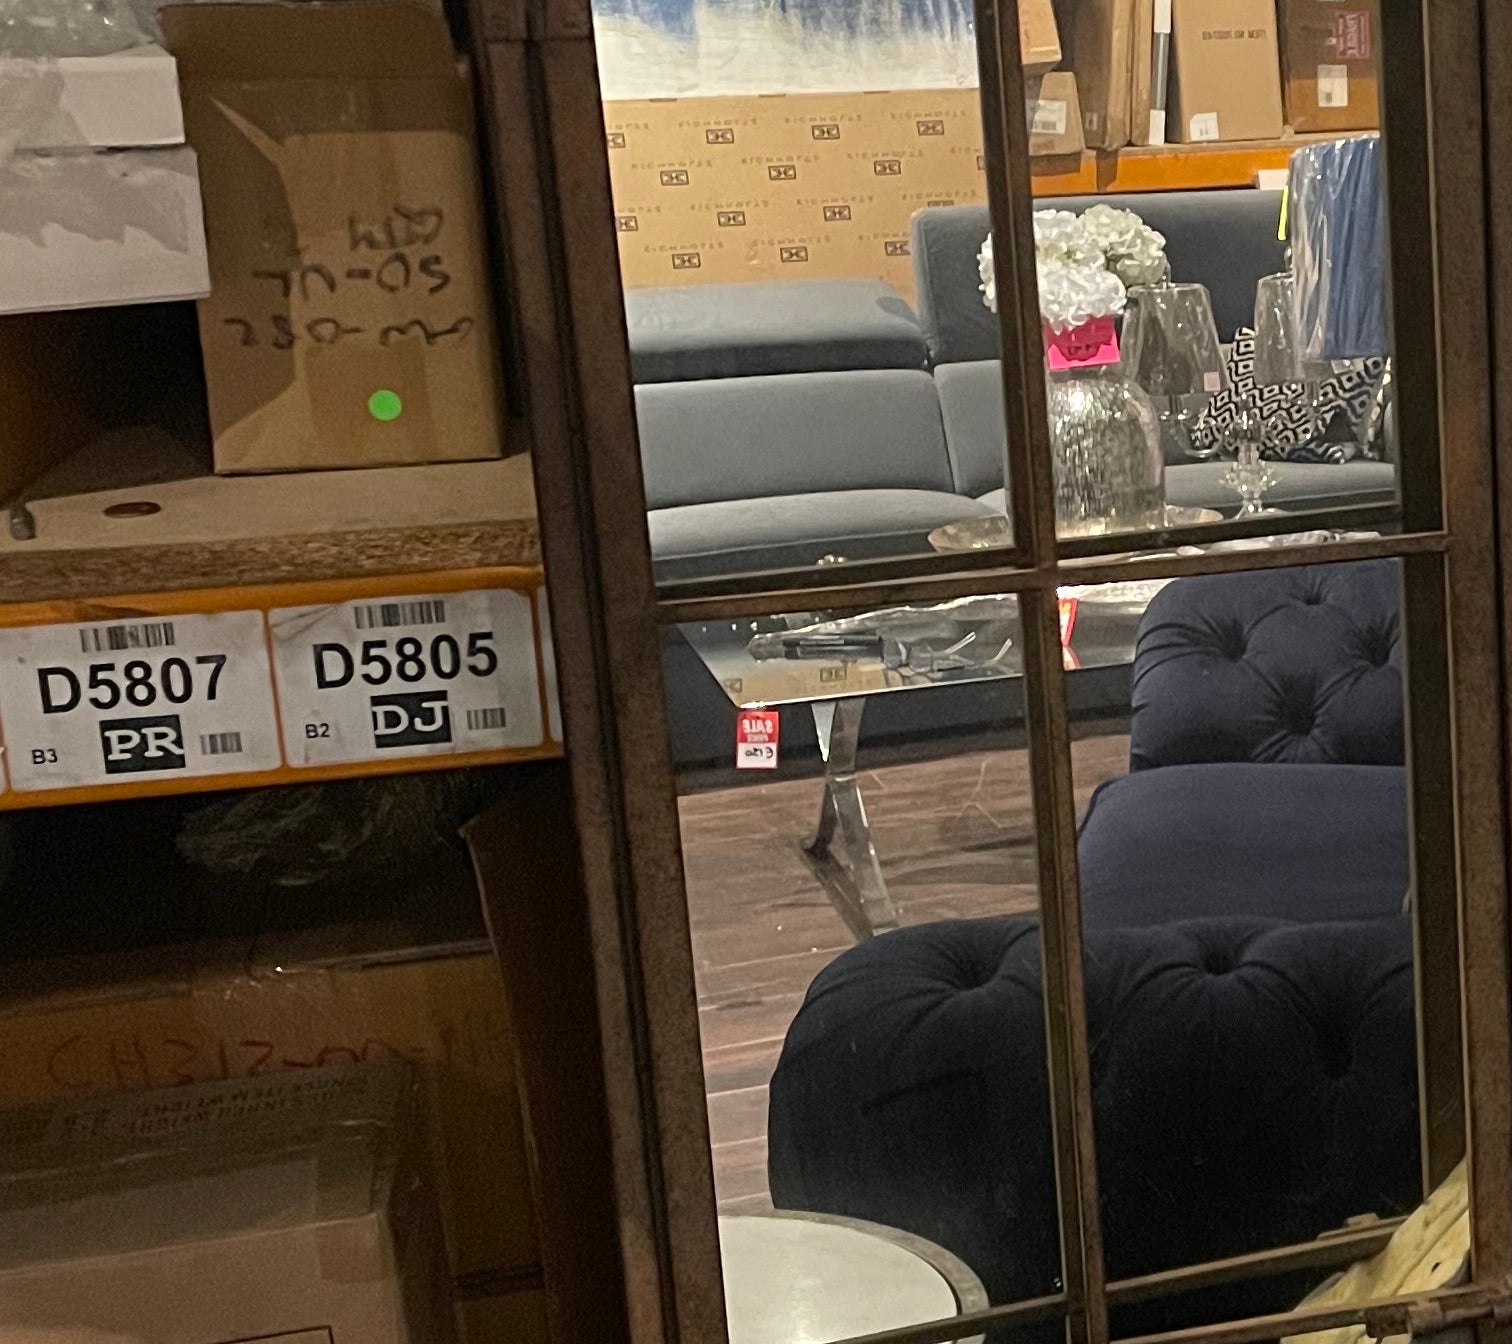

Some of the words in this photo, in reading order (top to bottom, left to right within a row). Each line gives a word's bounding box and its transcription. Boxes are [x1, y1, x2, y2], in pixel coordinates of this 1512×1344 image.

[37, 654, 227, 715] D5807
[312, 631, 499, 690] D5805
[305, 723, 331, 740] B2
[373, 700, 449, 737] DJ
[31, 748, 58, 765] B3
[103, 725, 184, 762] PR
